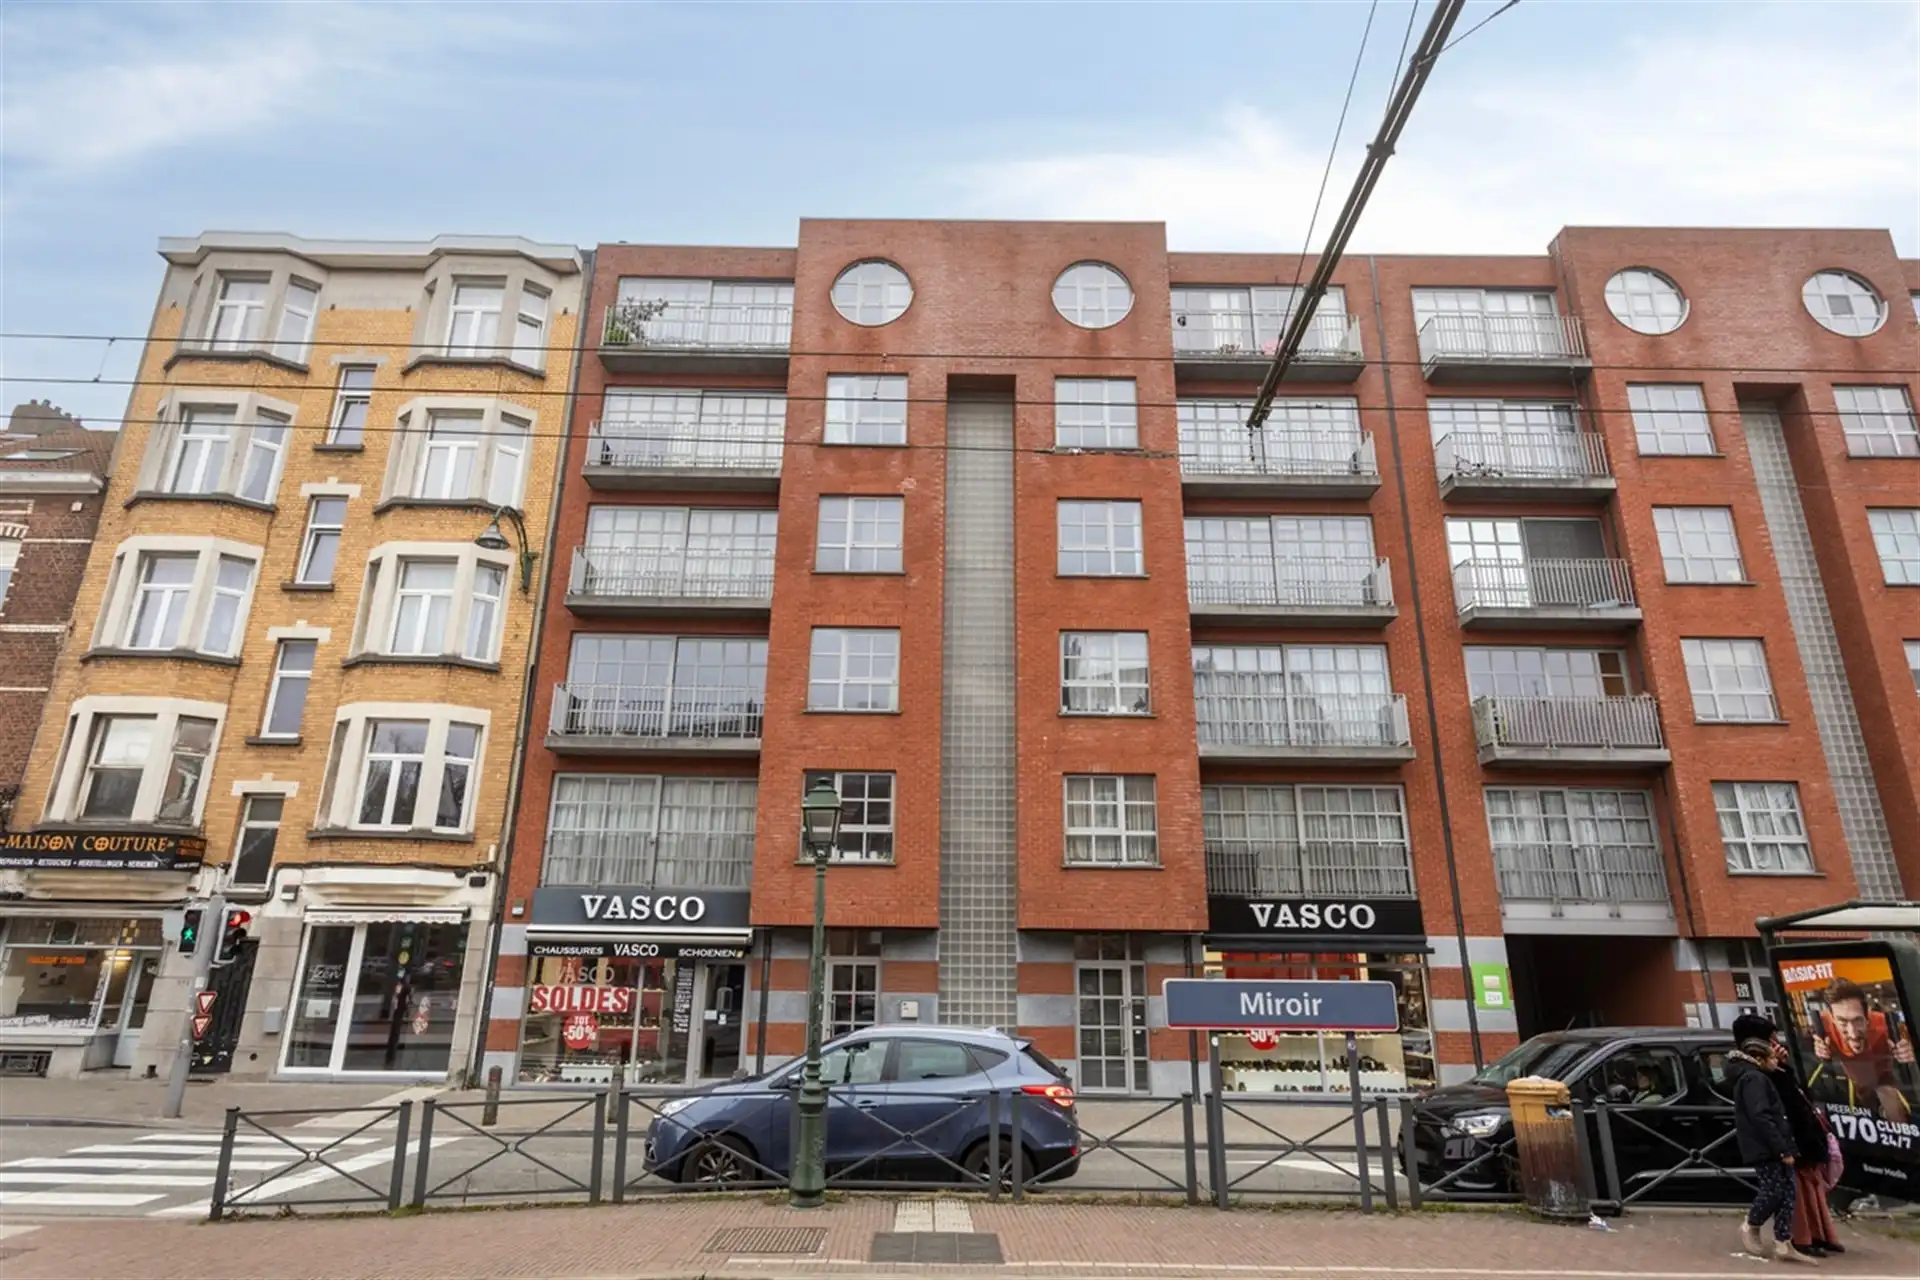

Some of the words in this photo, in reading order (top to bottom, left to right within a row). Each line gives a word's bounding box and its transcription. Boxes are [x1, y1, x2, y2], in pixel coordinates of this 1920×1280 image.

[5, 834, 78, 851] MAISON
[82, 836, 169, 852] COUTURE
[581, 894, 705, 921] VASCO
[1249, 903, 1376, 929] VASCO
[534, 946, 603, 956] CHAUSSURES
[613, 943, 659, 957] VASCO
[678, 947, 737, 958] SCHOENEN
[532, 985, 629, 1012] SOLDES
[1240, 992, 1323, 1016] Miroir
[574, 1016, 589, 1025] TOT
[564, 1025, 597, 1041] -50%
[1852, 1105, 1872, 1117] DAN
[1830, 1113, 1878, 1144] 170
[1876, 1119, 1920, 1137] CLUBS
[1880, 1133, 1911, 1149] 24/7
